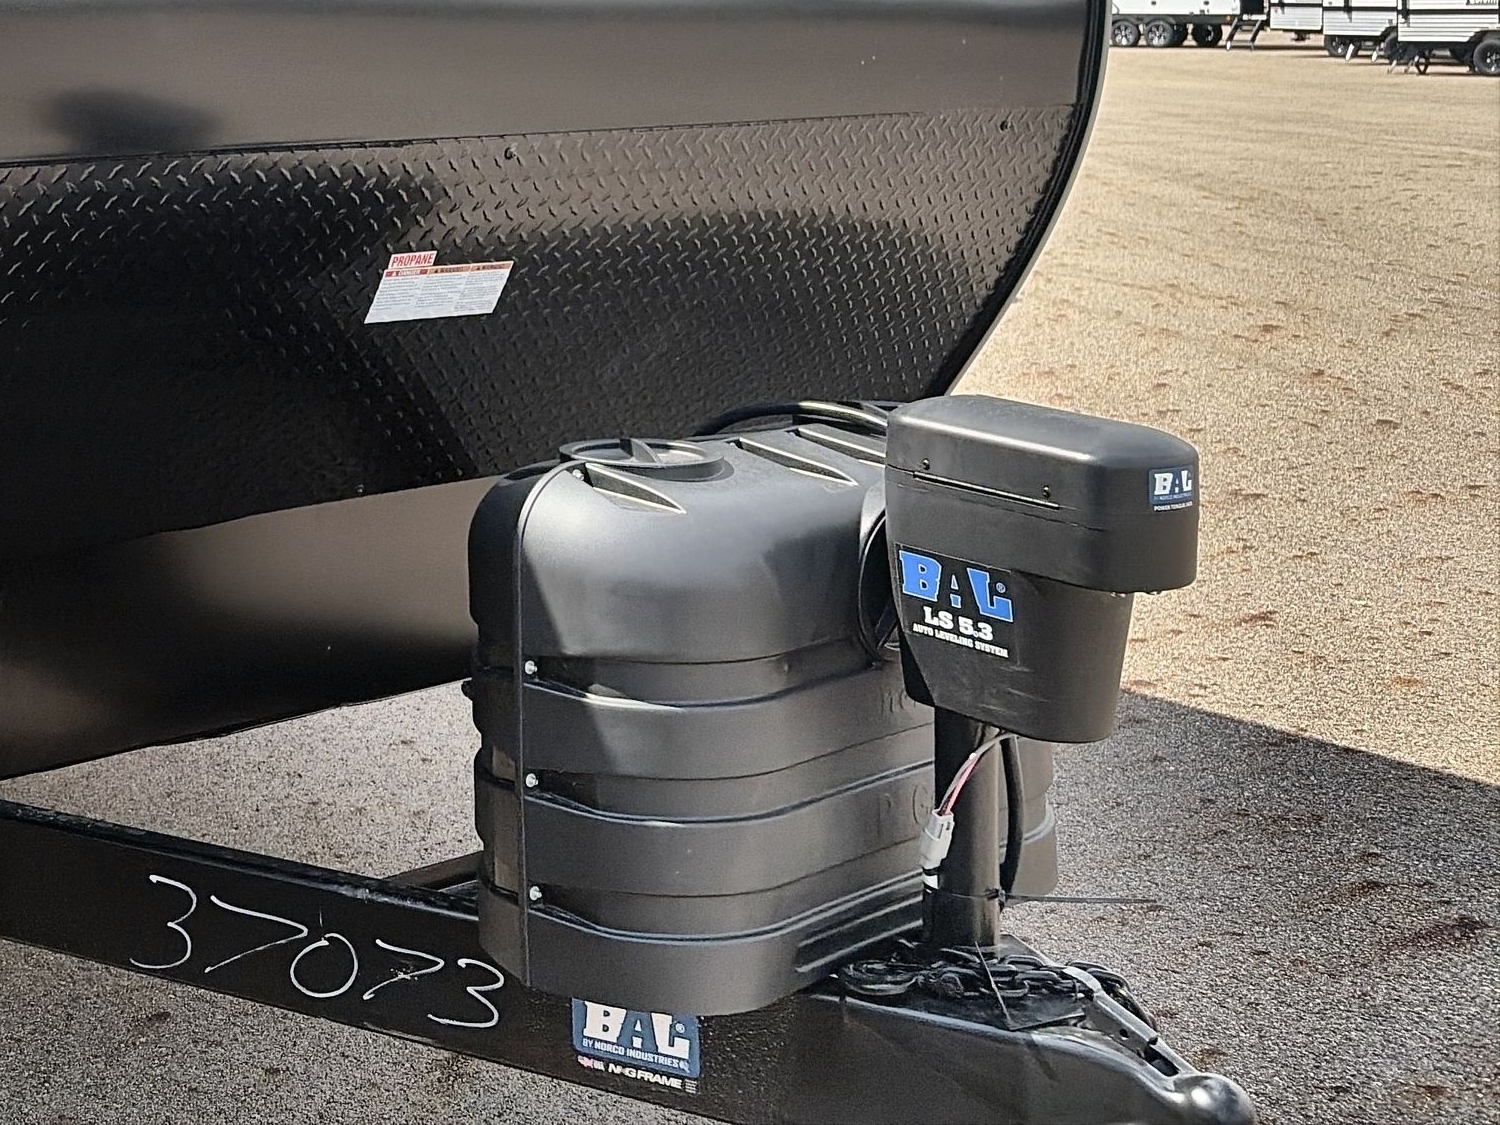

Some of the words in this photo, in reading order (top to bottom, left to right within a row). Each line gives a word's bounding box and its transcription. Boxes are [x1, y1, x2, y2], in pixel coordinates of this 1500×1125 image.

[391, 253, 435, 268] PROPANE
[1154, 470, 1192, 495] BAL
[899, 550, 1013, 623] BAL
[913, 623, 934, 636] AUTO
[935, 629, 973, 648] LEVELING
[975, 641, 1009, 658] SYSTEM
[923, 606, 954, 629] LS
[959, 616, 993, 641] 5.3
[129, 874, 505, 1029] 37073
[583, 1000, 690, 1059] BAL
[583, 1037, 594, 1049] BY
[594, 1040, 625, 1056] NORCO
[626, 1047, 680, 1069] INDUSTRIES
